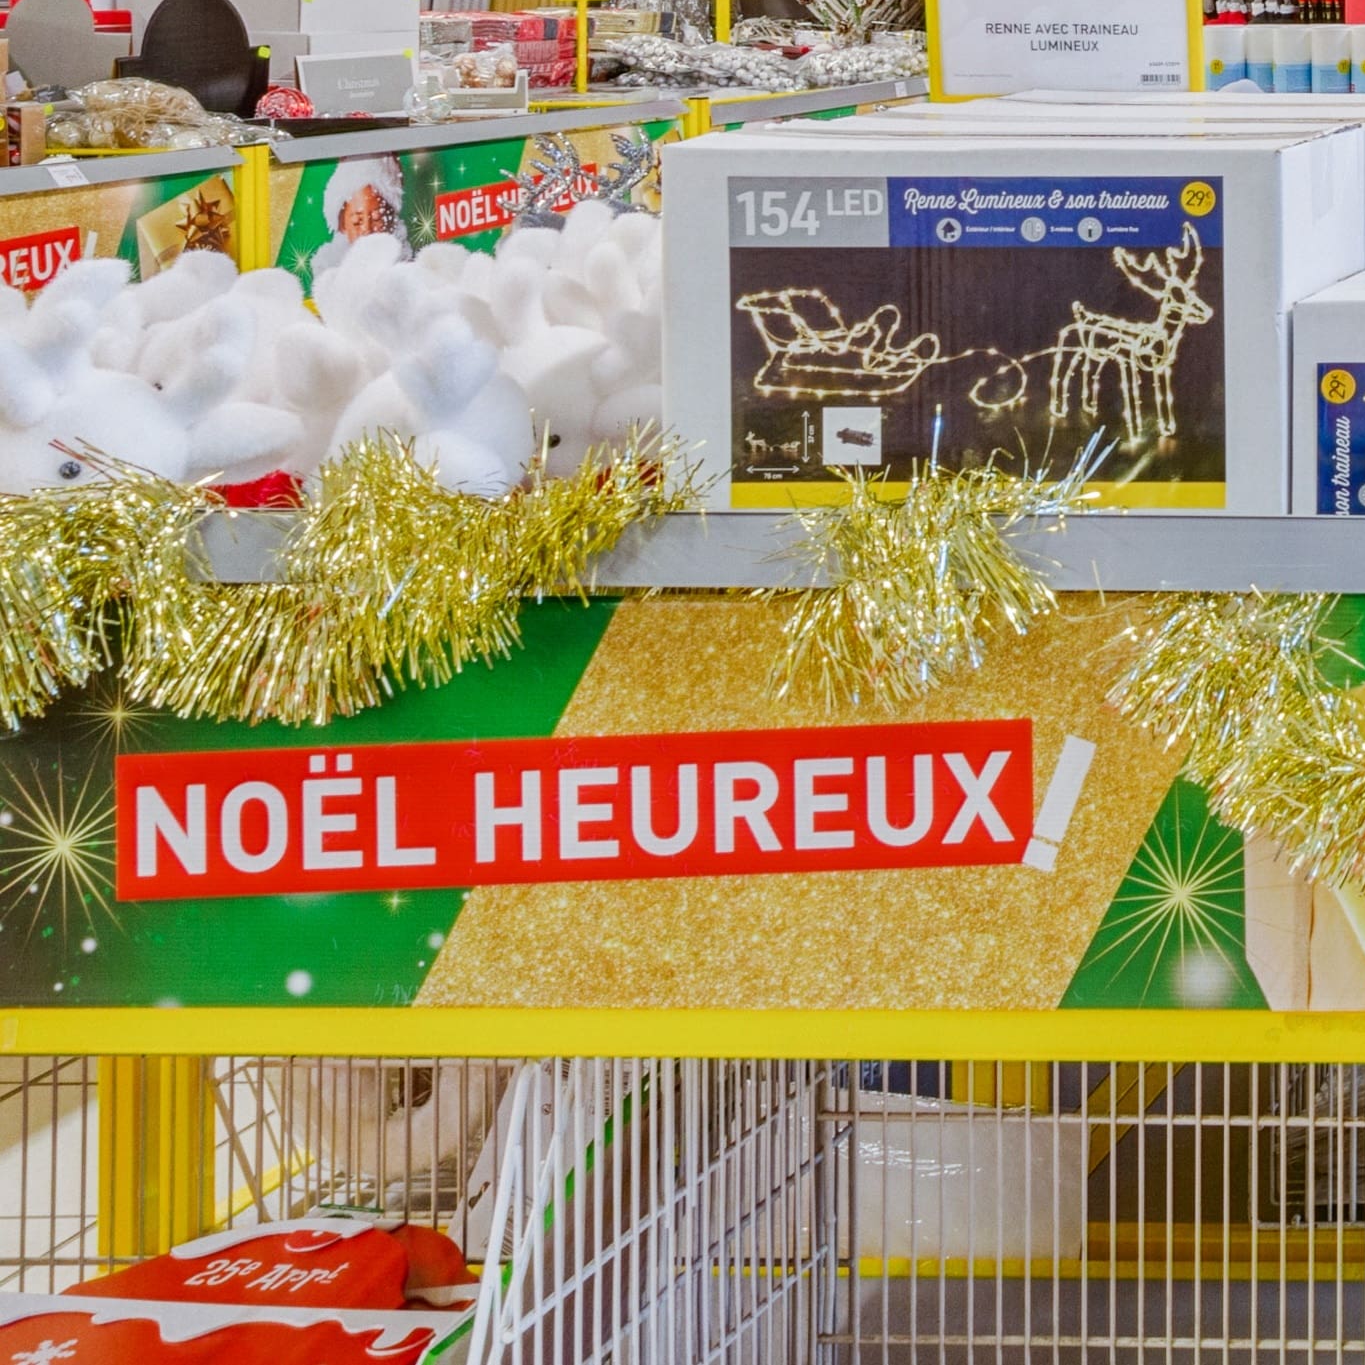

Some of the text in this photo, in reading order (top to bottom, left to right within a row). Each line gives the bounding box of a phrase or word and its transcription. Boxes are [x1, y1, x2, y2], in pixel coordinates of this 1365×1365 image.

[985, 22, 1139, 36] RENNE AVEC TRAINEAU
[1030, 40, 1100, 52] LUMINEUX
[439, 189, 498, 233] NOËL
[736, 189, 884, 236] 154 LED
[904, 188, 1170, 215] Renne Lumineux & son traineau
[1331, 416, 1351, 487] traineau
[136, 753, 437, 879] NOËL
